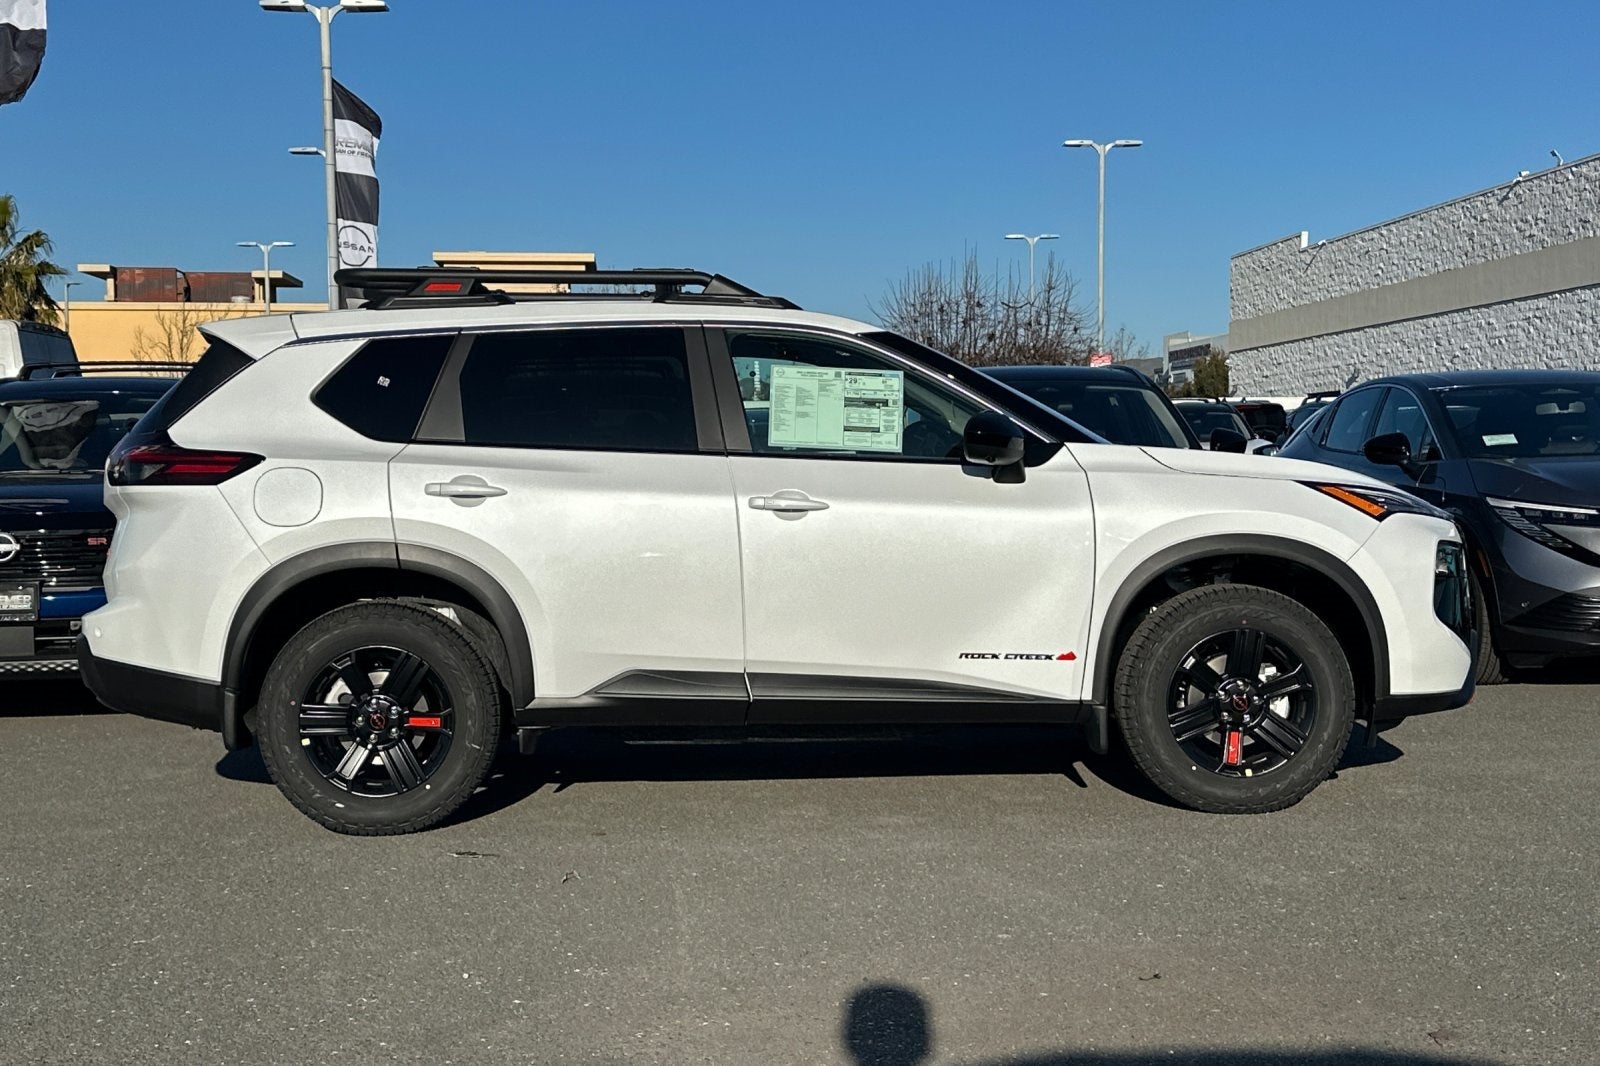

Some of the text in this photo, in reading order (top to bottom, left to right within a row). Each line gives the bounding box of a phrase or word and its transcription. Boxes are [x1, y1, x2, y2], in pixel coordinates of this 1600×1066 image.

[339, 241, 374, 253] ISSAN
[87, 537, 108, 546] SR
[0, 595, 32, 604] EMIER
[959, 652, 1055, 661] ROCK CREEK
